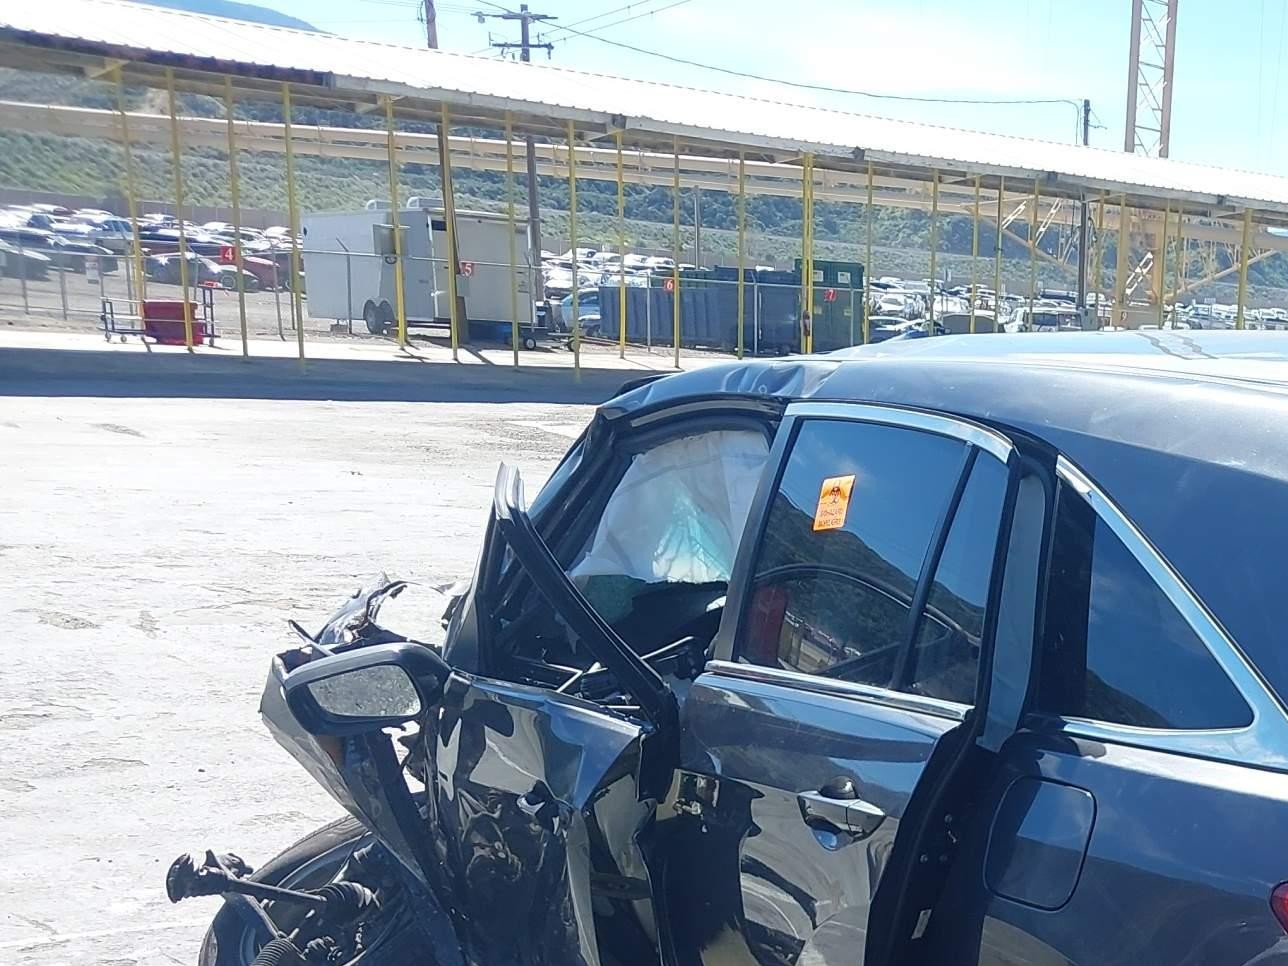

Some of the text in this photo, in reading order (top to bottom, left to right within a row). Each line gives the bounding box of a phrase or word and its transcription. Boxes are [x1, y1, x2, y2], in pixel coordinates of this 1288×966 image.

[224, 247, 233, 260] 4
[464, 263, 472, 276] 5
[666, 279, 673, 290] 6
[828, 289, 834, 301] 7
